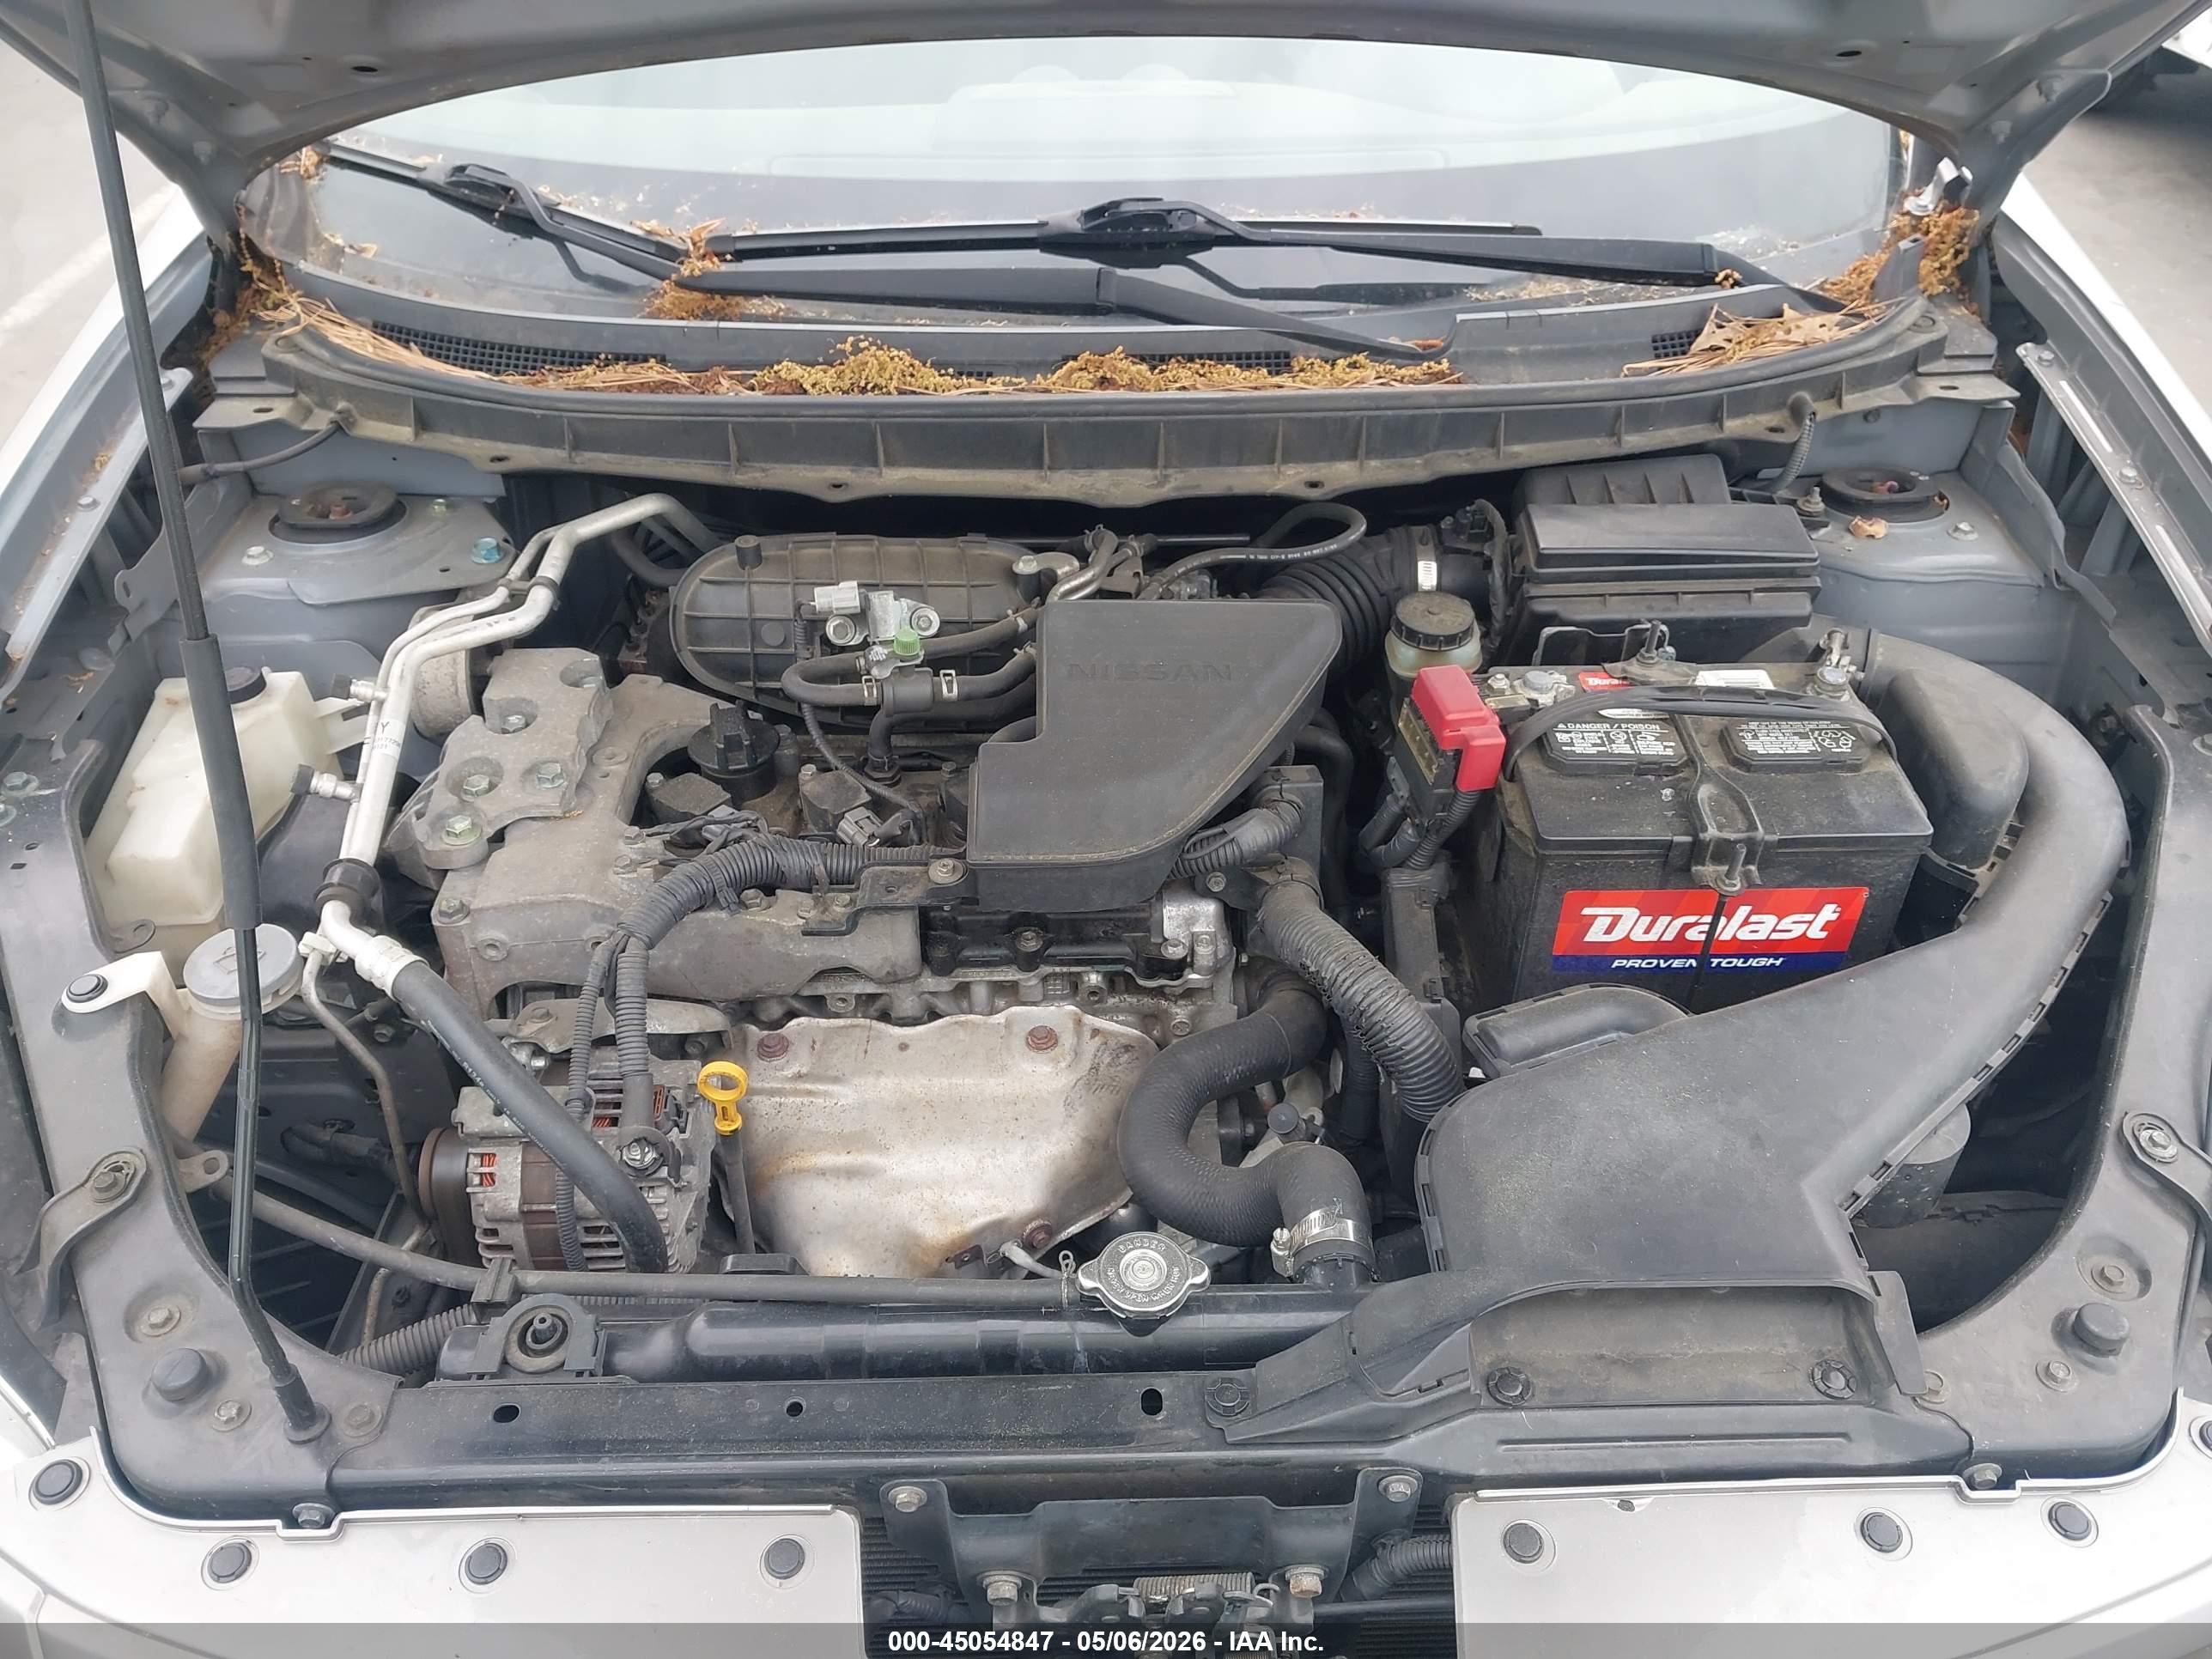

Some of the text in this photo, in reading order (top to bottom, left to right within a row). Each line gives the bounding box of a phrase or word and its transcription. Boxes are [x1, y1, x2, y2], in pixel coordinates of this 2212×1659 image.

[1069, 662, 1232, 682] NISSAN
[1581, 903, 1841, 943] Duralast
[1611, 957, 1784, 969] PROVEN TOUGH
[1118, 1239, 1165, 1253] DANGER
[1124, 1290, 1150, 1303] OPEN
[1151, 1283, 1176, 1300] WHEN
